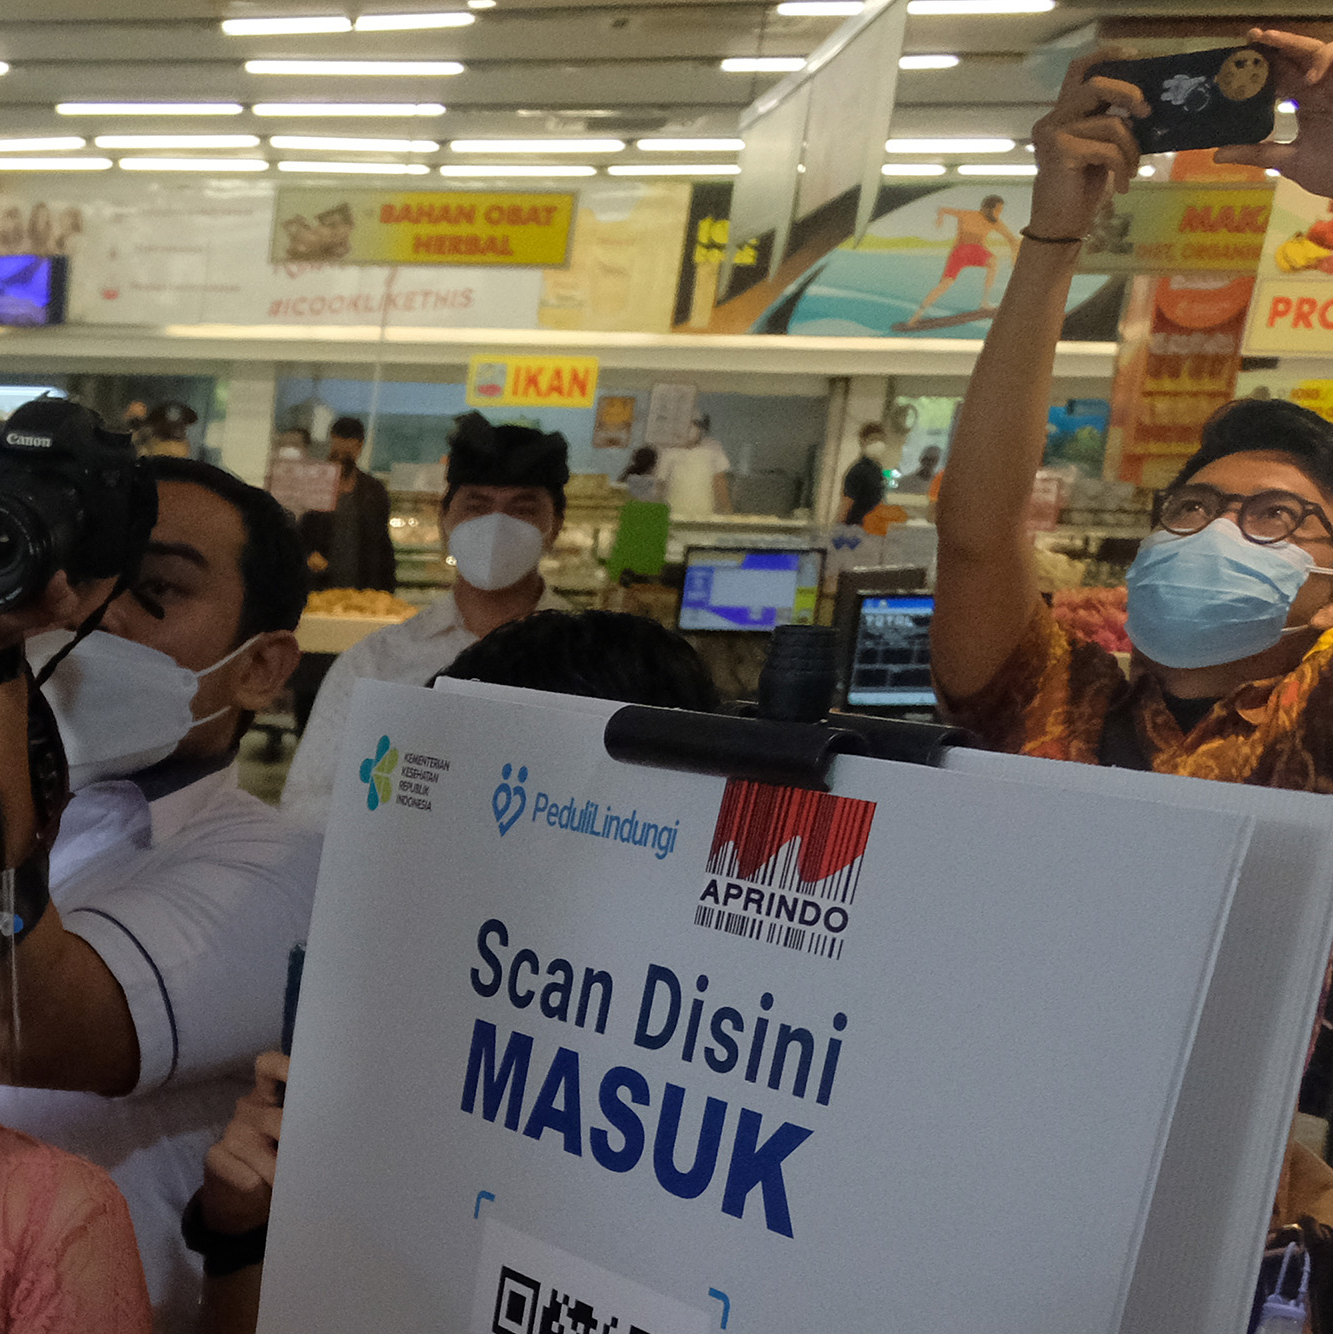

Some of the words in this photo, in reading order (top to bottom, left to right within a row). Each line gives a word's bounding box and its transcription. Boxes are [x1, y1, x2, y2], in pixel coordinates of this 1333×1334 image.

[380, 203, 476, 225] BAHAN
[484, 204, 558, 226] OBAT
[1178, 206, 1273, 234] MAK
[413, 234, 514, 257] HERBAL
[512, 365, 591, 398] IKAN
[6, 433, 52, 448] Canon
[403, 752, 451, 772] KEMENTERIAN
[400, 766, 440, 784] KESEHATAN
[398, 780, 430, 797] REPUBLIK
[395, 795, 433, 812] INDONESIA
[532, 791, 680, 860] PeduliLindungi
[699, 879, 849, 933] APRINDO
[469, 918, 613, 1035] Scan
[633, 962, 849, 1107] Disini
[459, 1017, 816, 1240] MASUK
